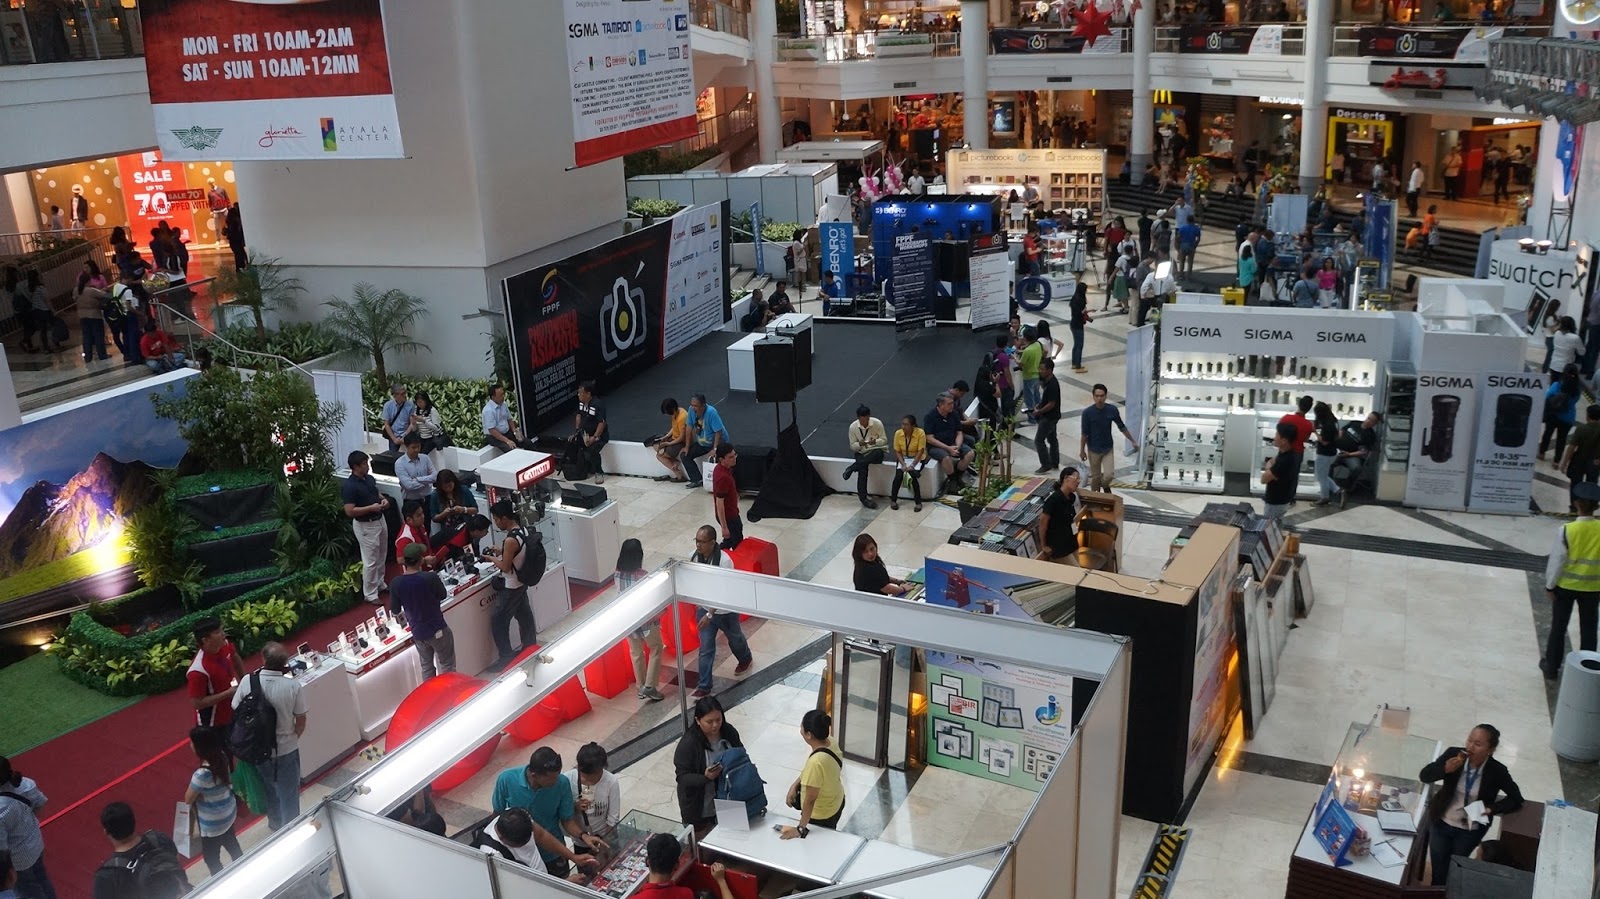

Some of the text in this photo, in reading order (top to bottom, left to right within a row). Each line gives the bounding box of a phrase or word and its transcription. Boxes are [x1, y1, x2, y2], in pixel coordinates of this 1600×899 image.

[602, 21, 632, 34] TAMRON
[182, 35, 219, 56] MON
[233, 32, 258, 53] FRI
[263, 27, 354, 51] 10AM-2AM
[182, 62, 208, 82] SAT
[223, 59, 254, 80] SUN
[259, 54, 360, 78] 10AM-12MN
[1336, 109, 1386, 121] Desserts
[259, 123, 304, 147] glorietta
[339, 125, 388, 134] AYALA
[340, 133, 390, 142] CENTER
[971, 154, 1014, 163] picturebooks
[1057, 154, 1101, 162] picturebooks
[133, 170, 172, 184] SALE
[191, 201, 210, 210] WITH
[895, 235, 914, 245] FPPF
[829, 228, 840, 273] BENRO
[1490, 258, 1573, 289] swatch
[541, 301, 560, 316] FPPF
[1173, 326, 1222, 338] SIGMA
[1244, 329, 1293, 341] SIGMA
[1316, 331, 1366, 343] SIGMA
[1420, 376, 1473, 389] SIGMA
[1488, 375, 1543, 390] SIGMA
[522, 462, 549, 482] Canon
[369, 655, 386, 668] Canon
[962, 700, 975, 708] BIR
